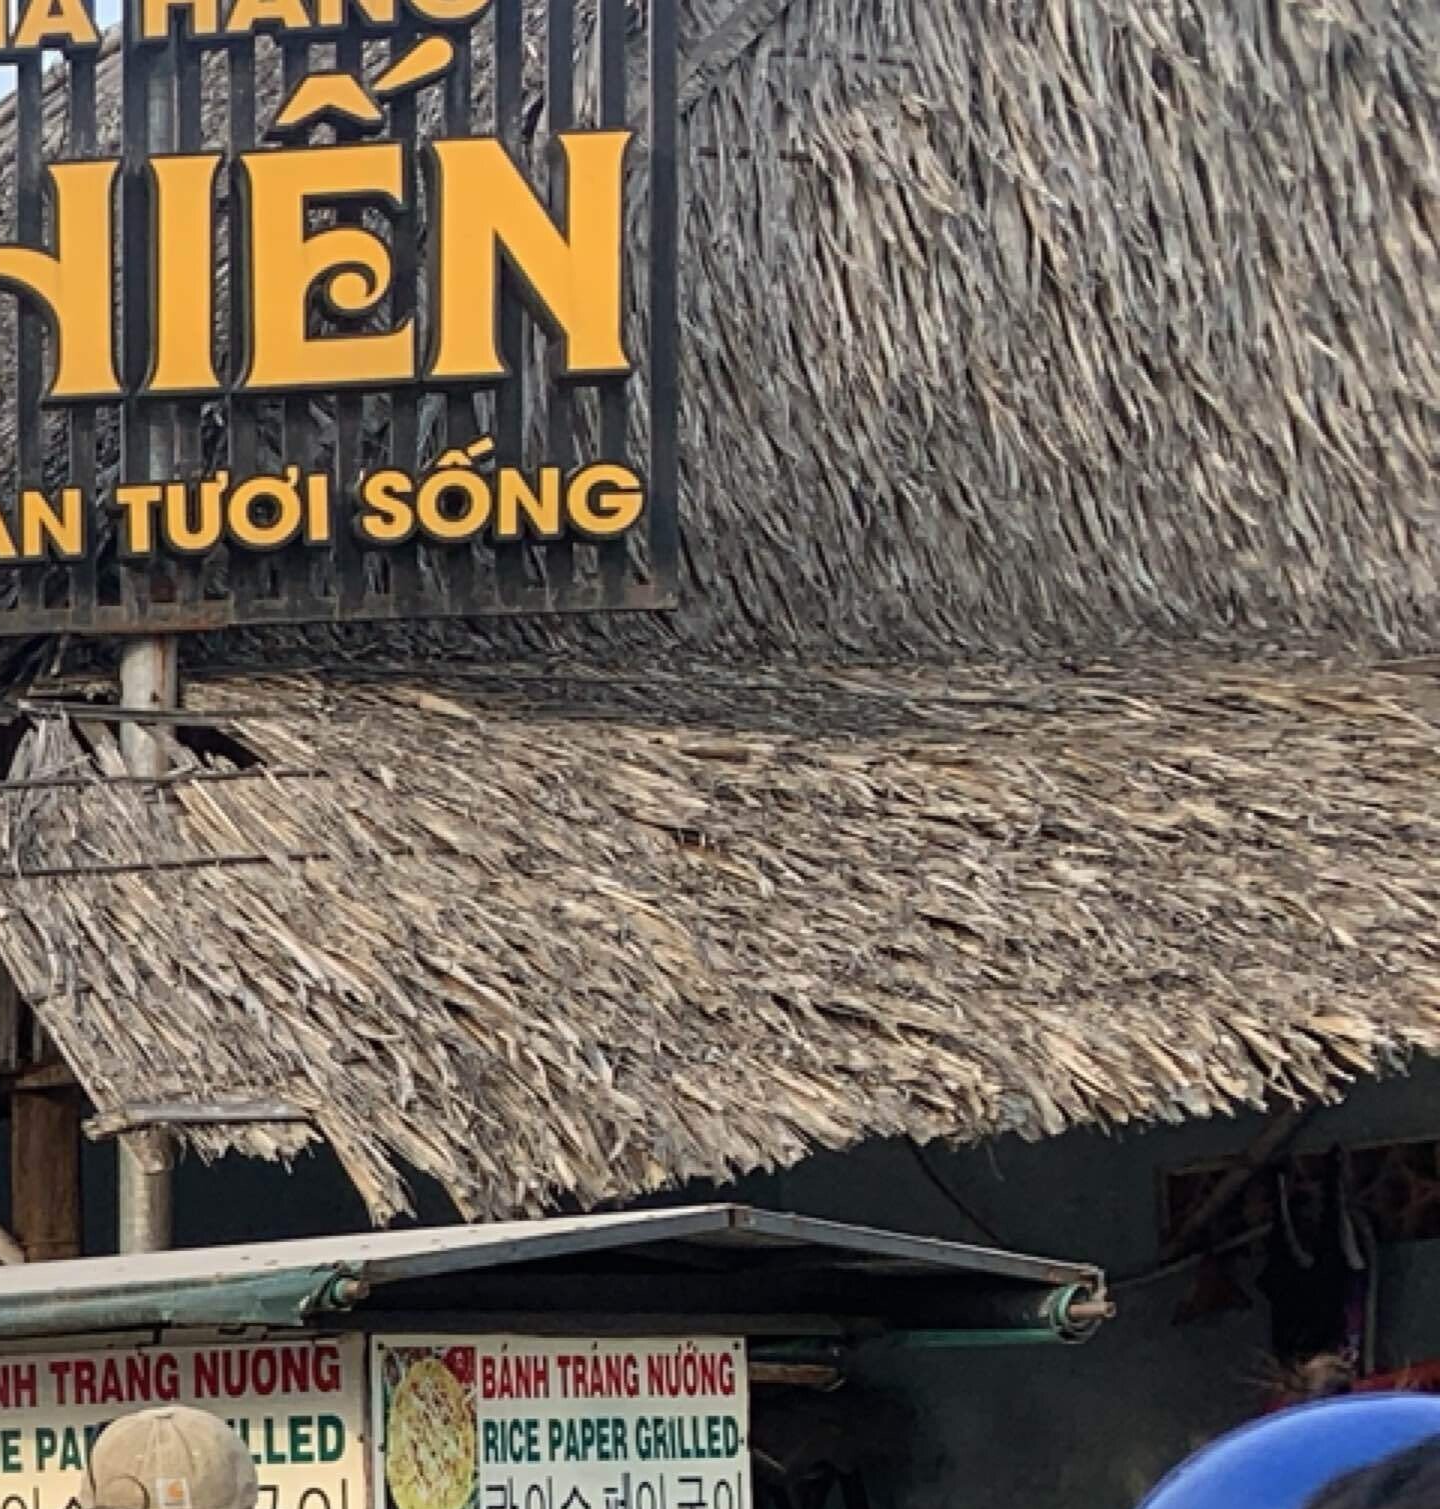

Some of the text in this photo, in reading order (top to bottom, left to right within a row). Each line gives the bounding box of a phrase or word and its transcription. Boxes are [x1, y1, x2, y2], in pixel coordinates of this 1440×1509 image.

[117, 471, 330, 555] TƯƠI
[362, 438, 645, 542] SỐNG
[484, 1416, 740, 1463] RICE PAPER GRILLED
